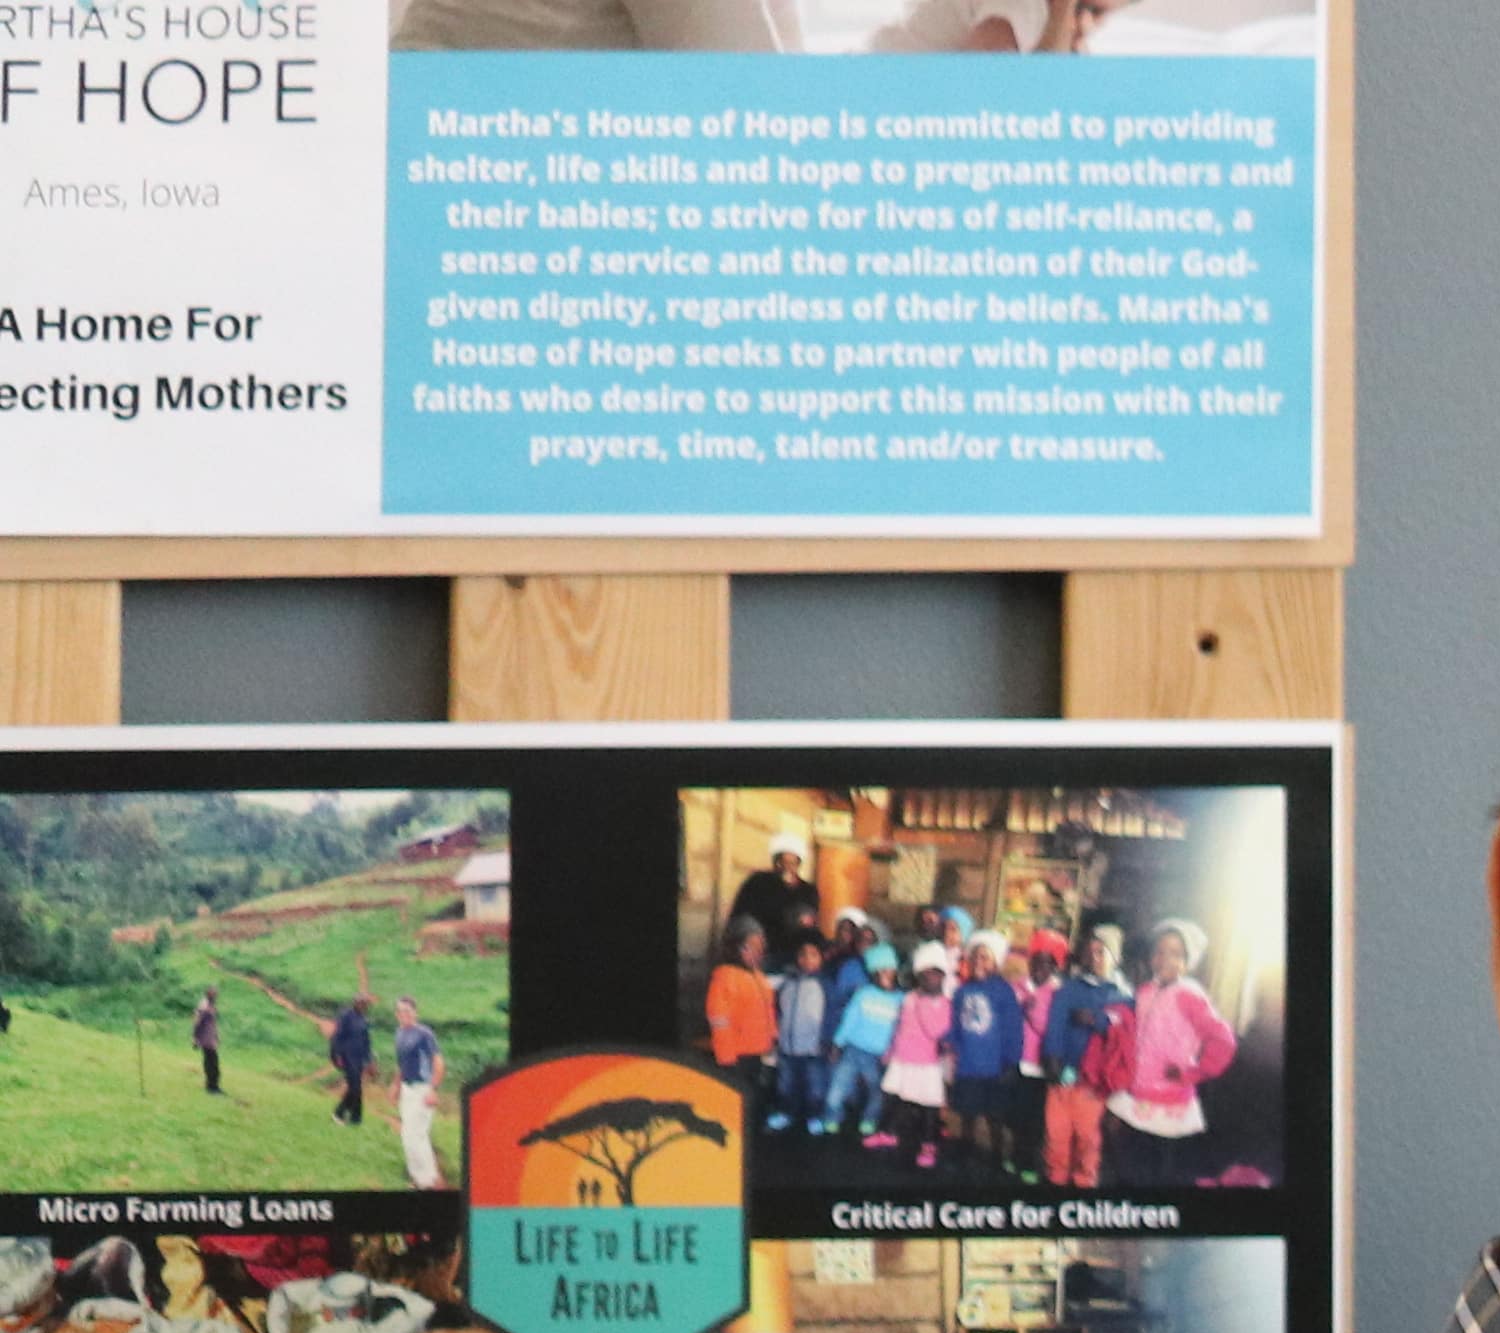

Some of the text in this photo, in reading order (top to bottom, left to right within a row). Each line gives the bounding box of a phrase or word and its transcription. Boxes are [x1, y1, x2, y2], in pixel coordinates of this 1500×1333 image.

[163, 5, 319, 40] HOUSE
[1, 58, 318, 125] F HOPE
[427, 108, 1277, 149] Martha's House of Hope is committed to providing
[408, 153, 1295, 193] shelter, life skills and hope to pregnant mothers and
[23, 177, 220, 211] Ames, Iowa
[446, 199, 1254, 236] their babies; to strive for lives of self-reliance, a
[0, 307, 262, 342] A Home For
[155, 374, 348, 412] Mothers
[38, 1196, 334, 1228] Micro Farming Loans
[831, 1200, 1180, 1229] Critical Care for Children
